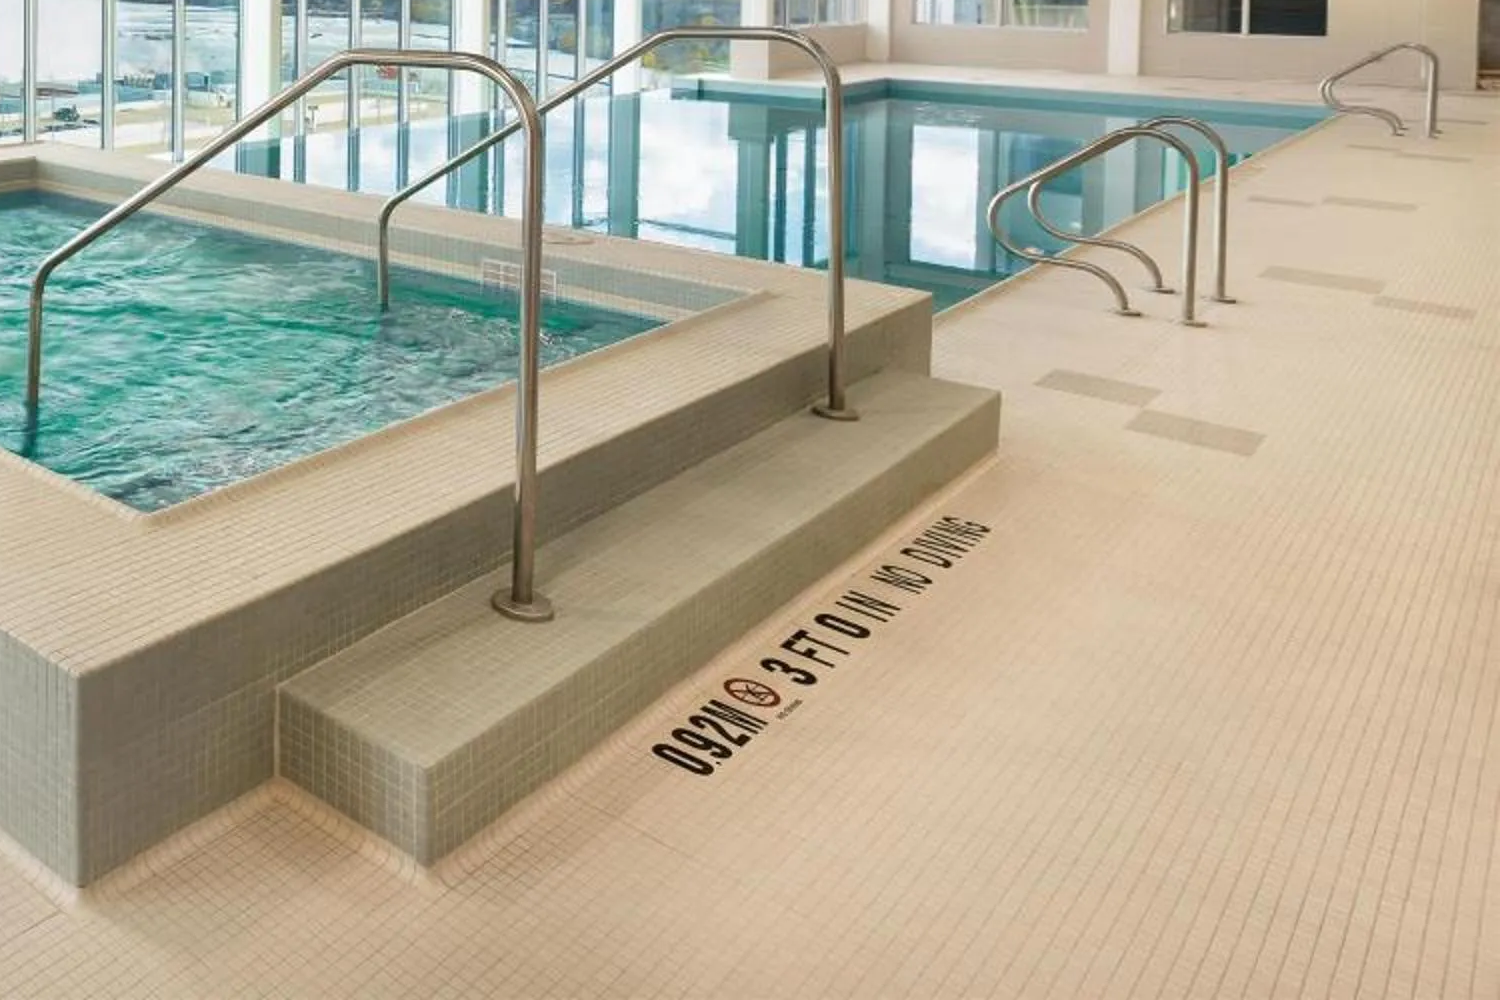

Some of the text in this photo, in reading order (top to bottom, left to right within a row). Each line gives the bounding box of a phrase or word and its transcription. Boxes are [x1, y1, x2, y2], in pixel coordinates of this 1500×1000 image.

[900, 516, 990, 568] DIVING
[869, 565, 932, 594] NO
[835, 590, 901, 623] IN
[780, 629, 850, 668] FT
[760, 658, 817, 685] 3
